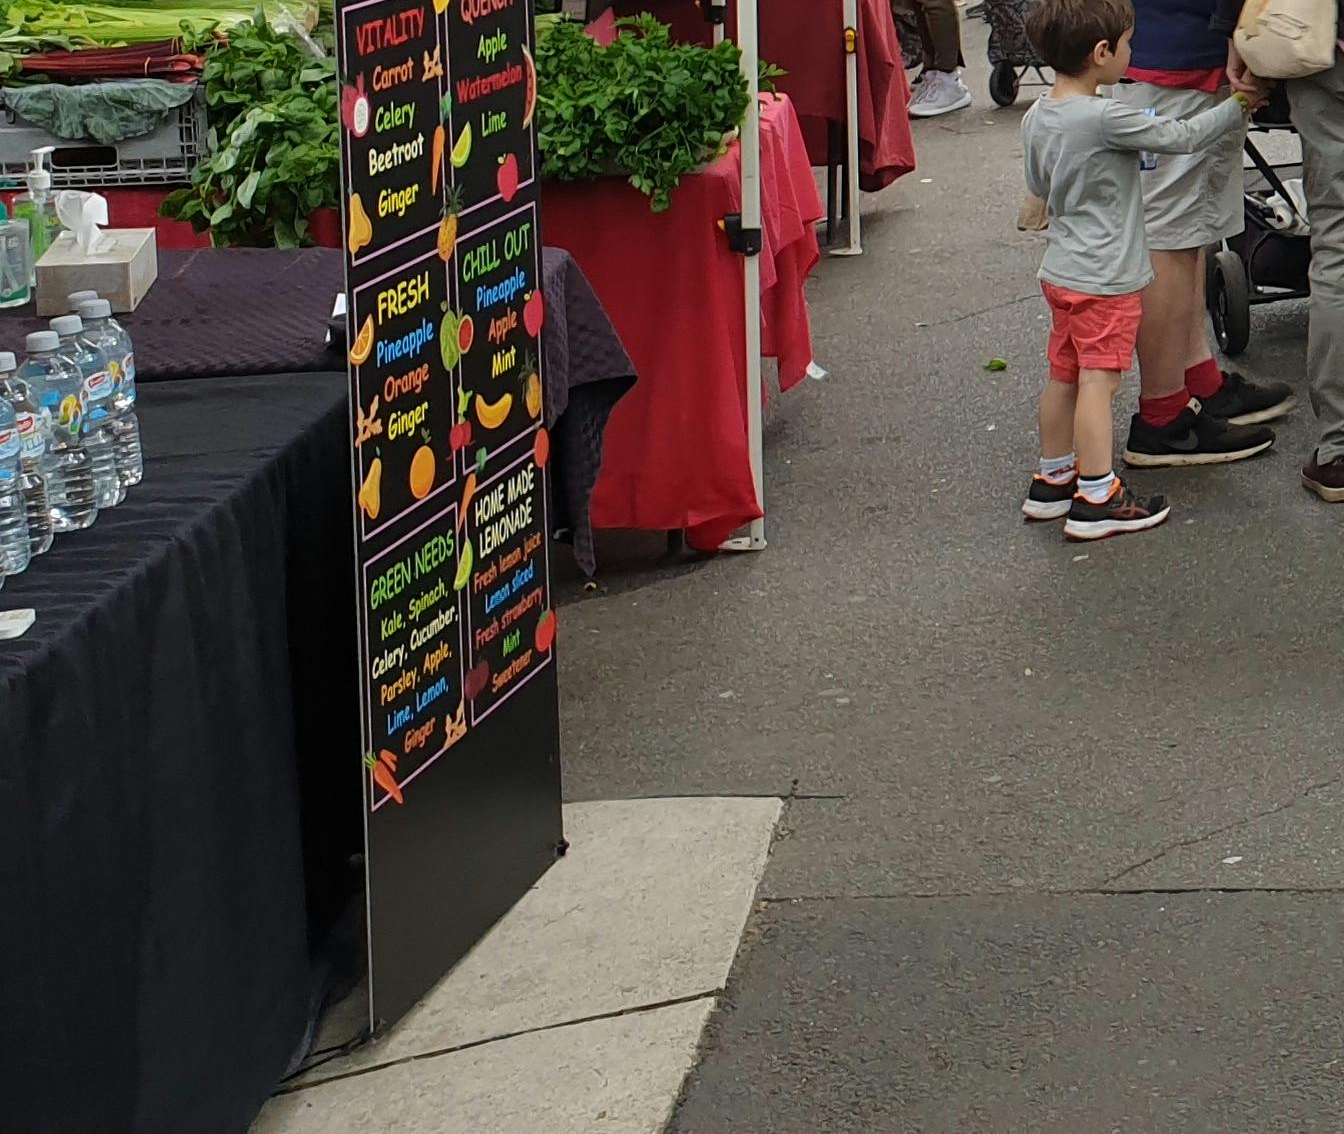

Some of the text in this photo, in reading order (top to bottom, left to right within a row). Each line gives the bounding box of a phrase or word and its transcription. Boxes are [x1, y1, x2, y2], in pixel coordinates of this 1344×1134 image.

[355, 6, 426, 57] VITALITY
[477, 27, 508, 64] Apple
[372, 56, 415, 92] Carrot
[456, 61, 523, 105] Watermelon
[375, 102, 416, 134] Celery
[481, 110, 508, 138] Lime
[368, 132, 425, 177] Beetroot
[378, 182, 420, 218] Ginger
[462, 222, 531, 284] CHILL OUT
[376, 270, 430, 326] FRESH
[476, 266, 526, 312] Pineapple
[376, 317, 434, 368] Pineapple
[487, 309, 518, 344] Apple
[384, 363, 430, 403] Orange
[491, 345, 517, 379] Mint
[387, 401, 429, 441] Ginger
[475, 462, 535, 528] HOME MADE
[479, 496, 533, 559] LEMONADE
[370, 529, 454, 610] GREEN NEEDS
[474, 560, 498, 595] Fresh
[523, 531, 542, 562] juice
[485, 558, 535, 615] Lemon sliced
[381, 577, 449, 642] Kale, Spinach,
[475, 585, 544, 651] Fresh strawberry
[423, 640, 452, 675] Apple,
[503, 627, 521, 657] Mint
[387, 676, 449, 736] Lime, Lemon,
[404, 716, 436, 754] Ginger
